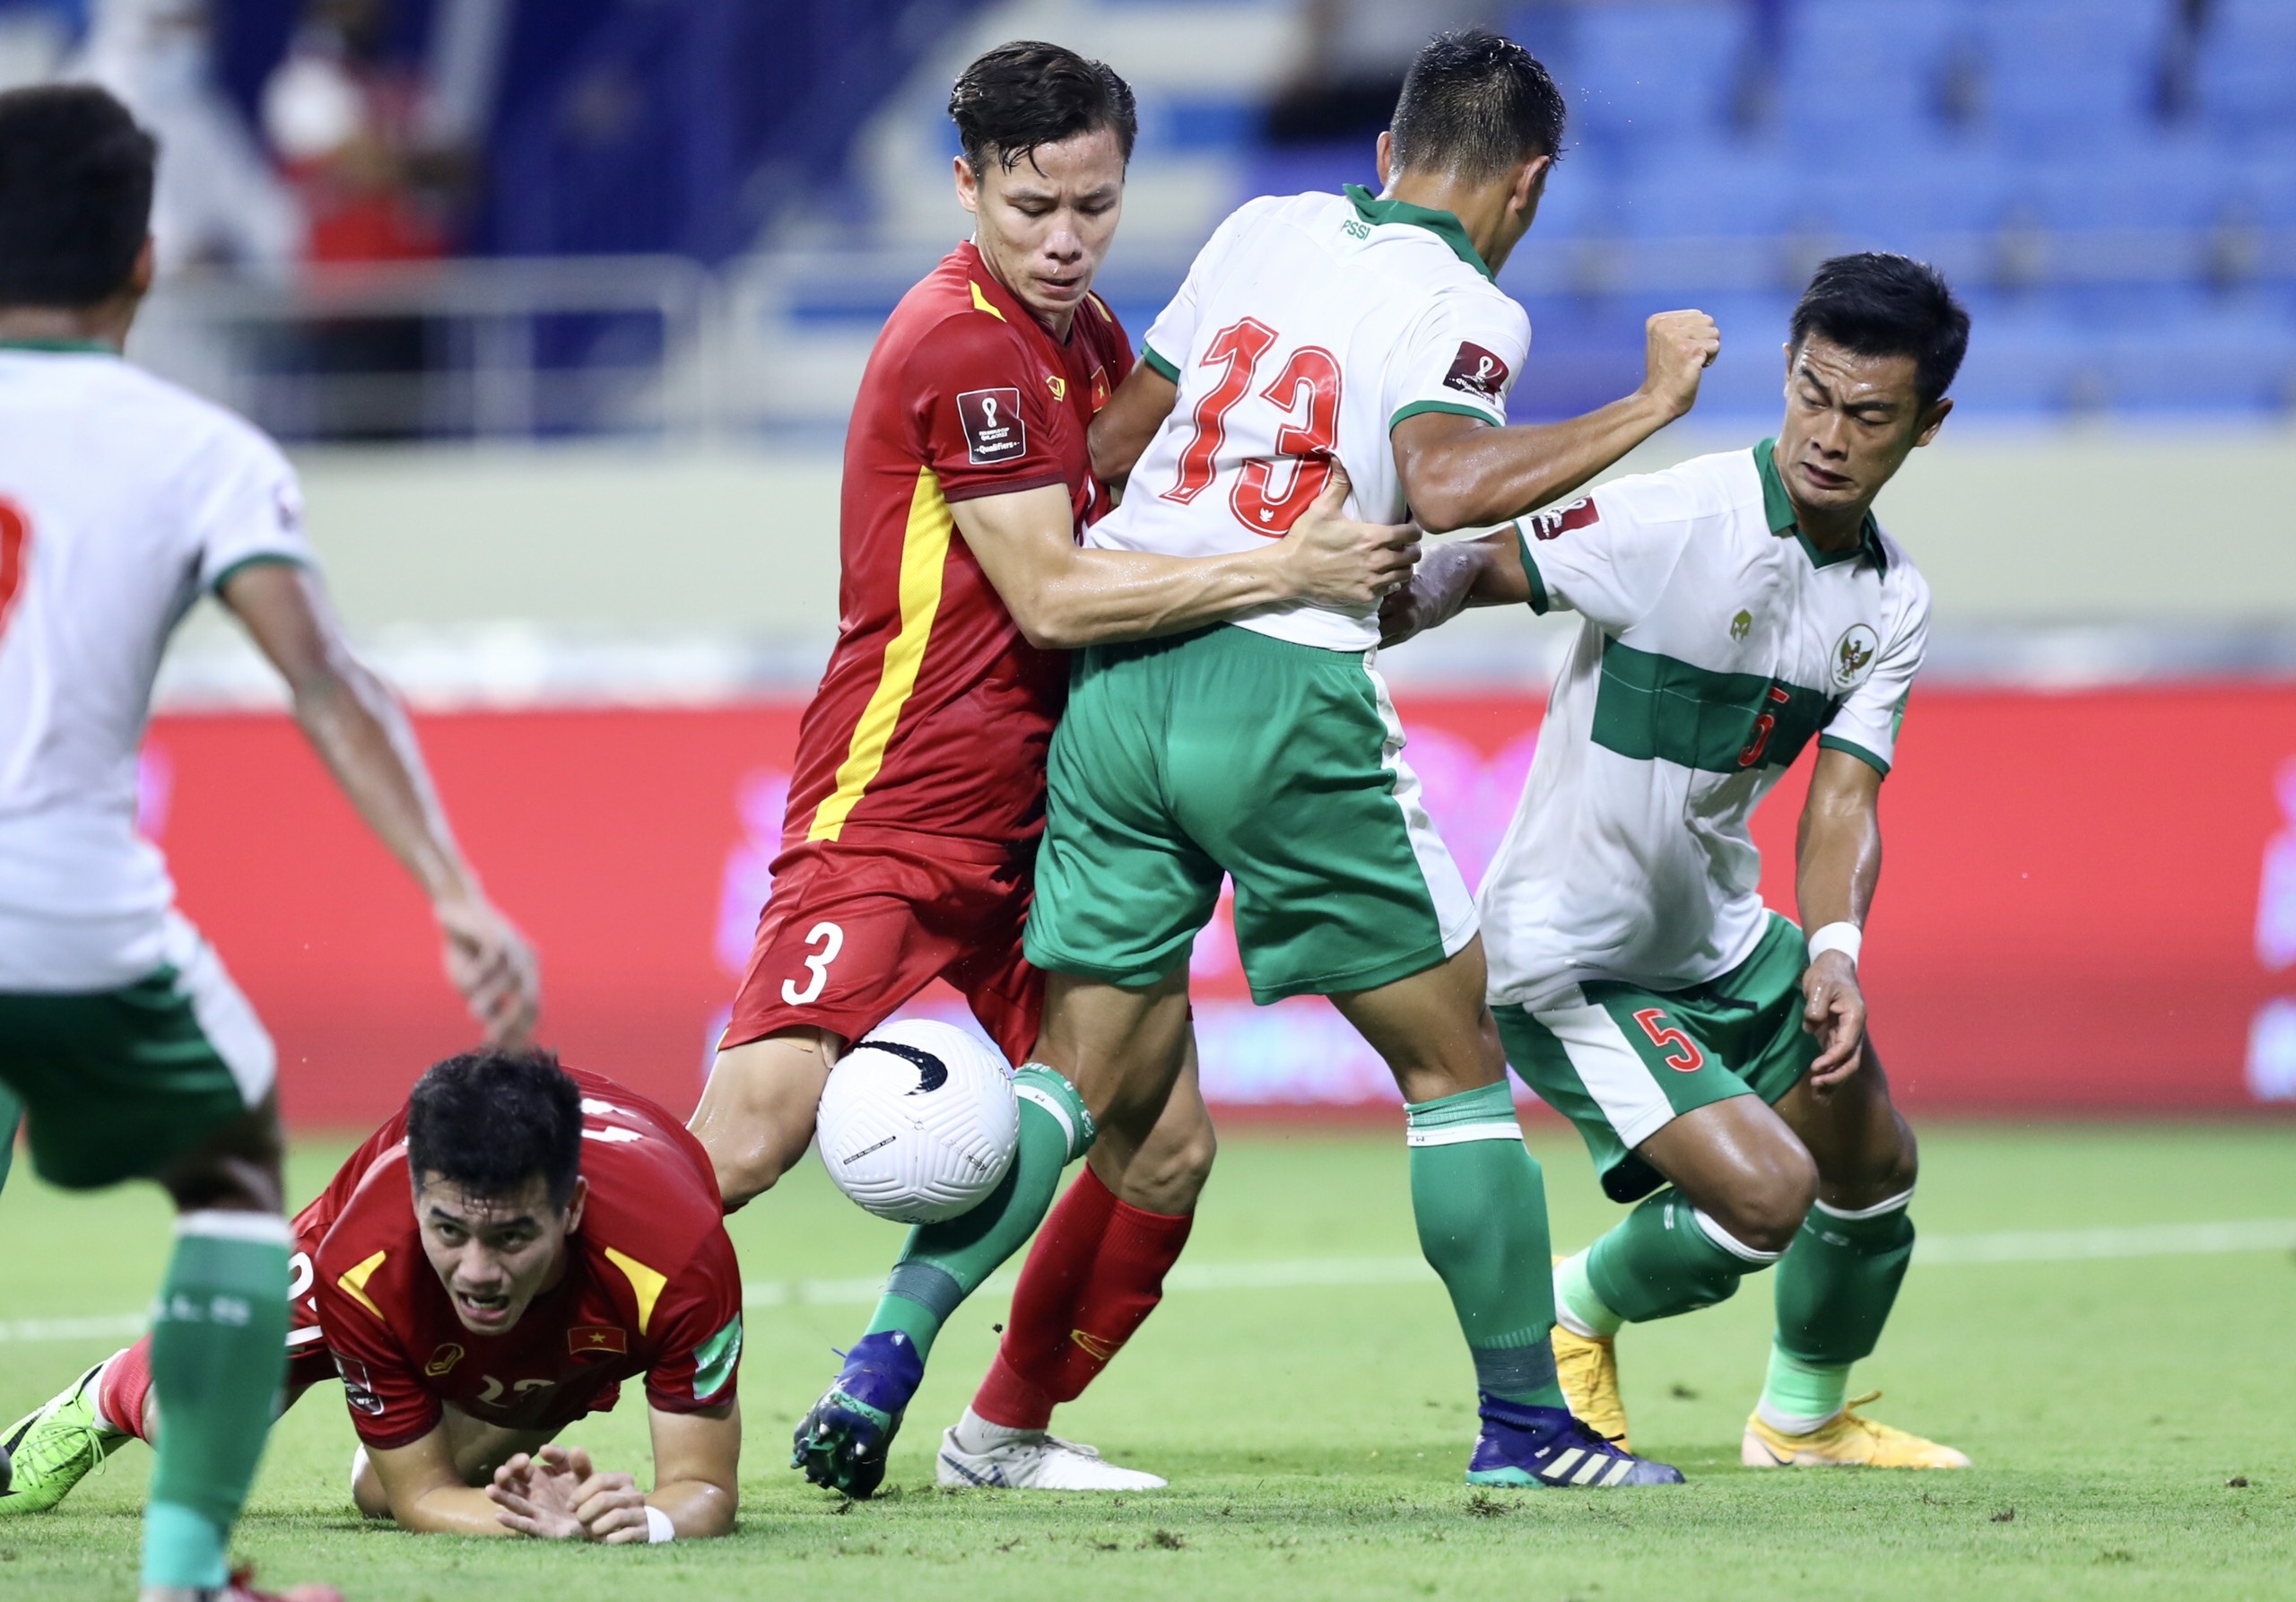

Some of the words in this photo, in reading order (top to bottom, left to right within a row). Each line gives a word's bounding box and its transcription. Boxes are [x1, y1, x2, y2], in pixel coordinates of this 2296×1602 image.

[1340, 219, 1371, 241] PSSI
[978, 441, 1013, 454] Qualifiers
[1157, 316, 1343, 539] 13
[781, 921, 844, 1006] 3
[1632, 1007, 1704, 1073] 5
